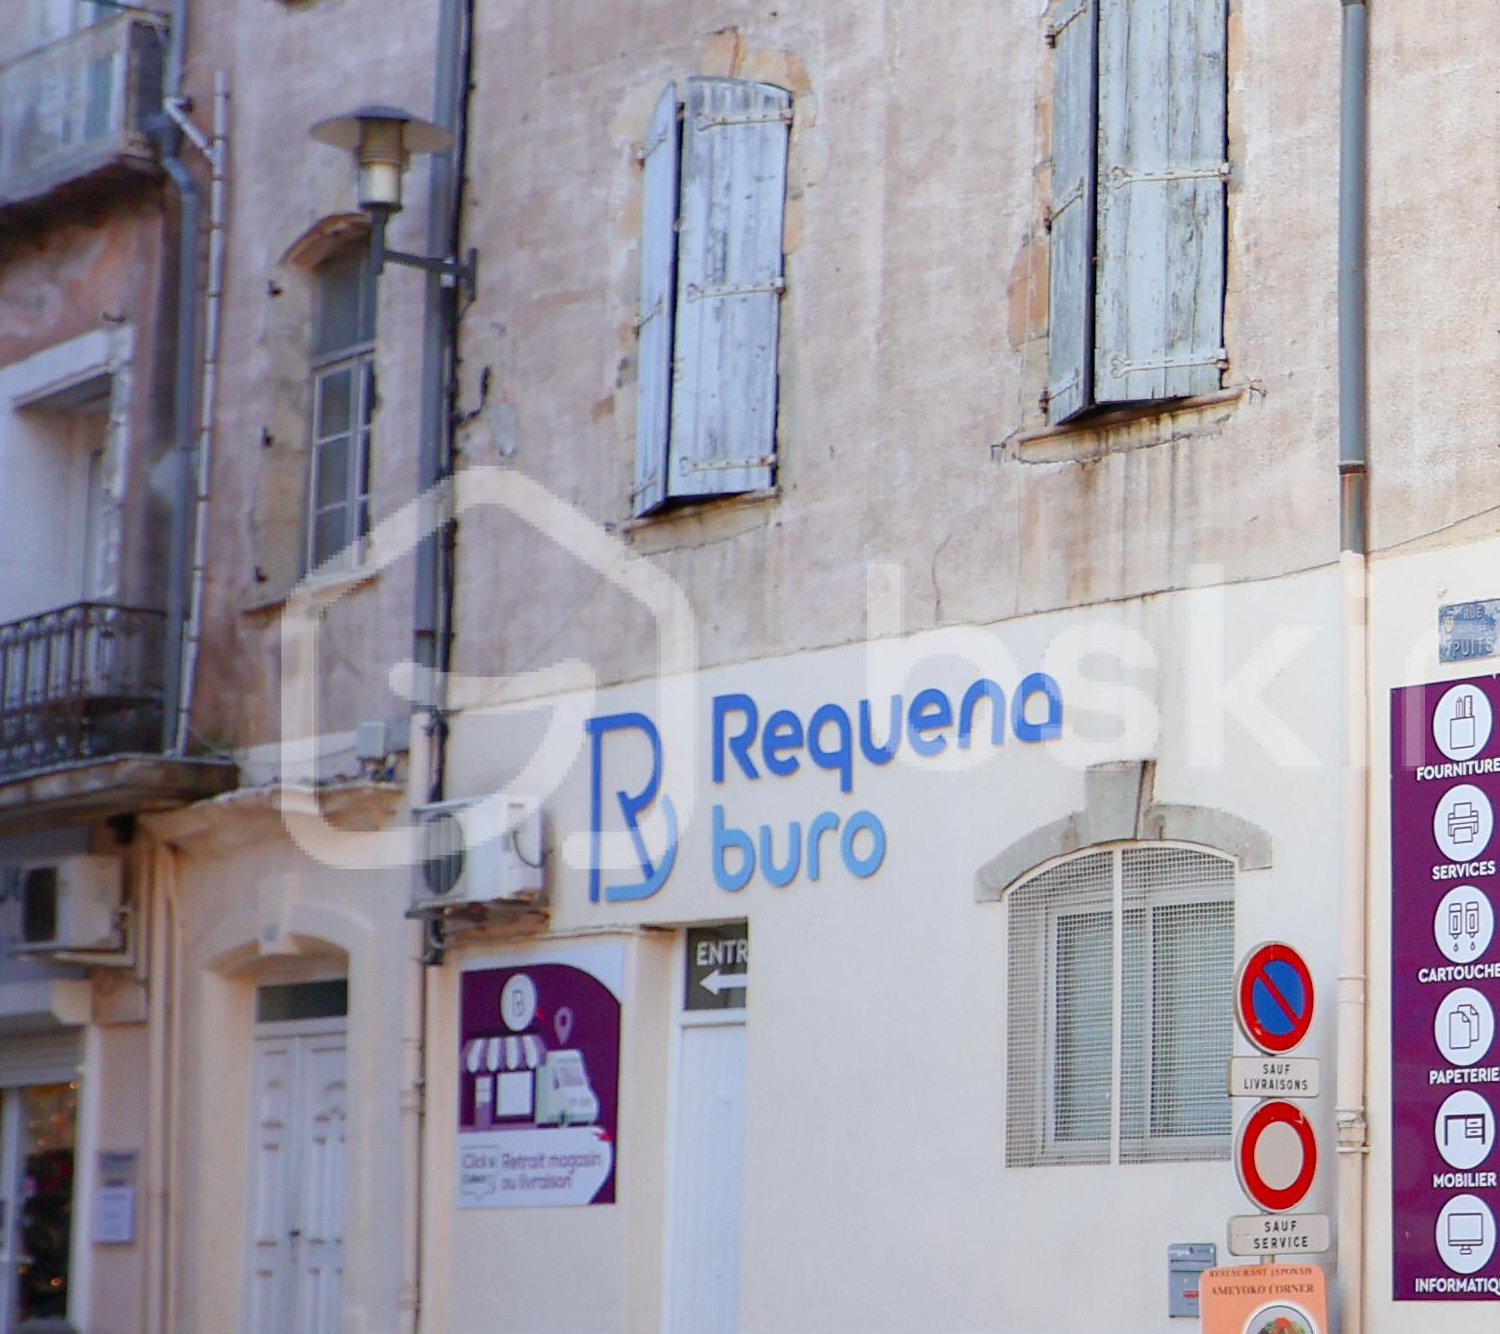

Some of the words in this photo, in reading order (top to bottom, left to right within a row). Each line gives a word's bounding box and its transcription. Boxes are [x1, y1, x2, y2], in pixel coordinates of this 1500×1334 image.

[1452, 636, 1494, 659] PUITS
[712, 672, 1063, 795] Requena
[712, 804, 886, 893] buro
[1432, 860, 1496, 881] SERVICES
[1262, 1064, 1291, 1075] SAUF
[1429, 1066, 1500, 1085] PAPETERIE
[1243, 1078, 1309, 1091] LIVRAISONS
[501, 1152, 545, 1169] Retrait
[548, 1152, 601, 1176] magasin
[518, 1172, 572, 1190] livraison
[1433, 1171, 1497, 1189] MOBILIER
[1264, 1221, 1298, 1233] SAUF
[1253, 1236, 1309, 1250] SERVICE
[1268, 1283, 1314, 1295] CORNER
